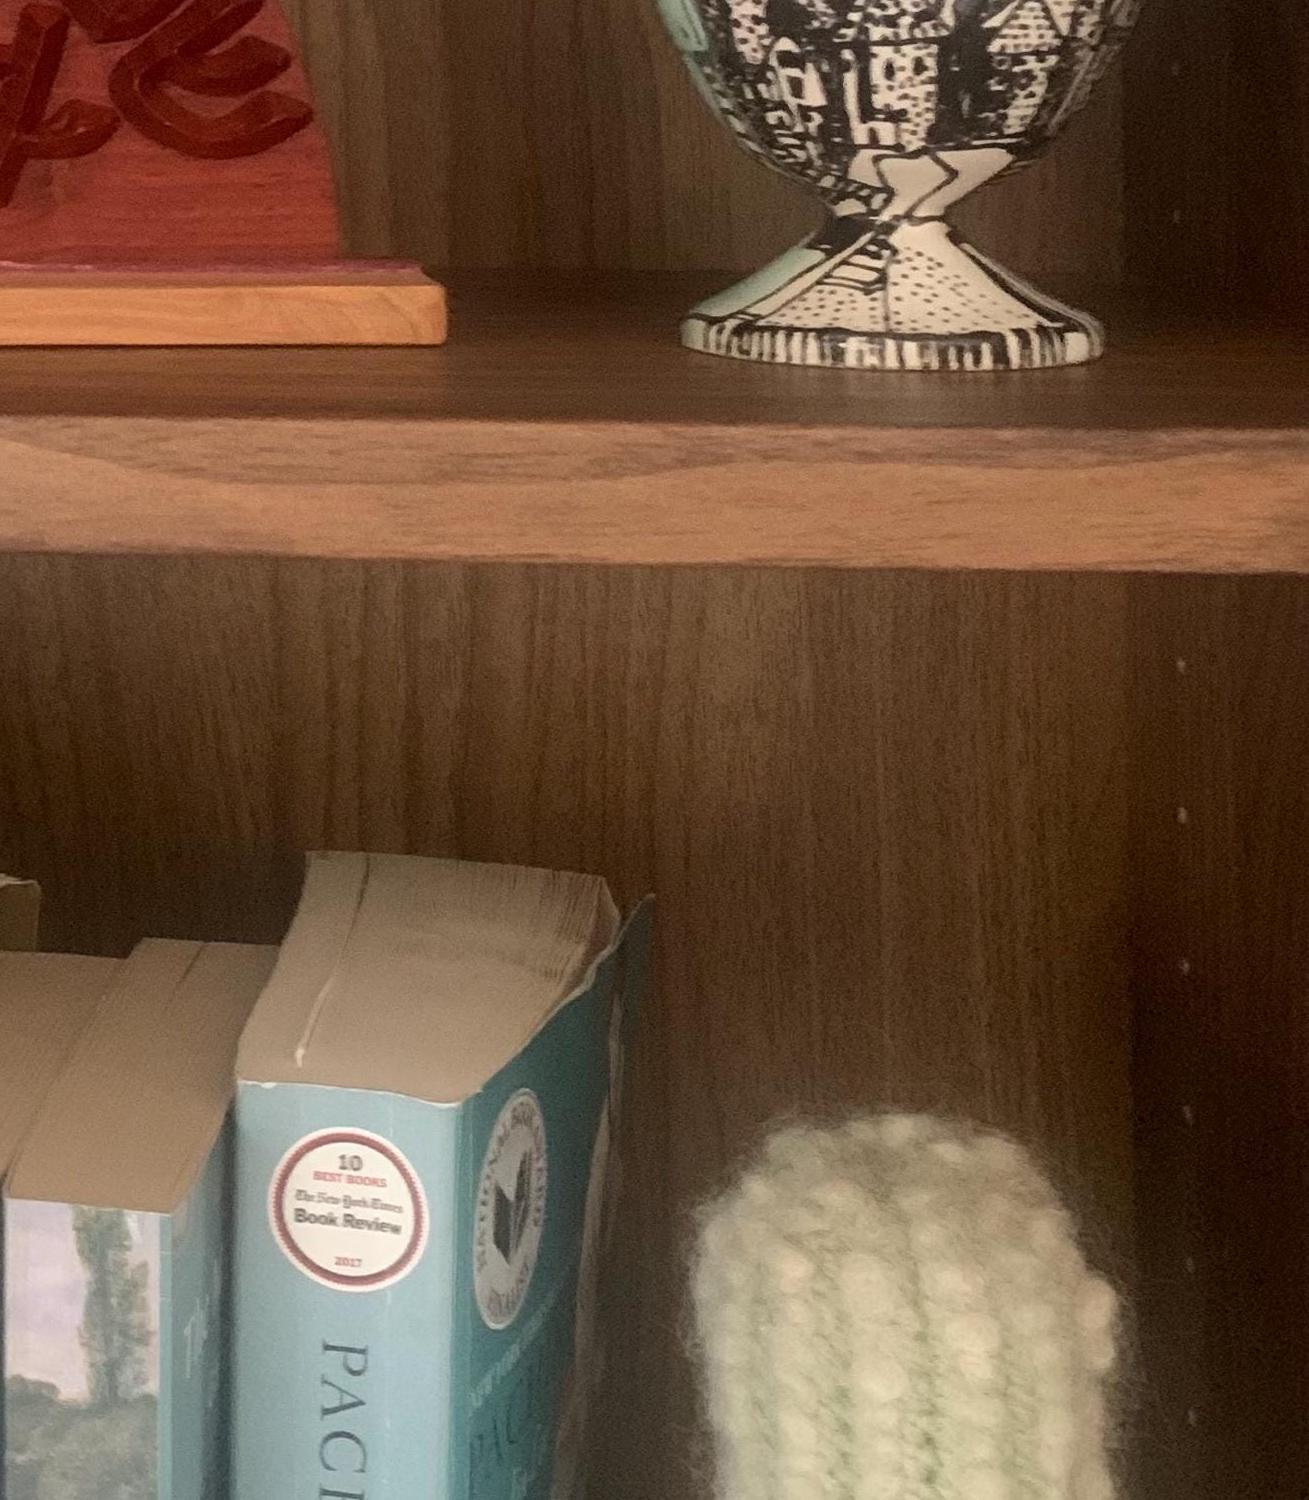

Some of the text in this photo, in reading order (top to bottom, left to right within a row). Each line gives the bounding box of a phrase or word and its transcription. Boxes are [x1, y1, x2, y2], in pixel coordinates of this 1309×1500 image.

[338, 1154, 363, 1171] 10
[313, 1170, 387, 1188] BEST BOOKS
[293, 1208, 402, 1235] Book Review
